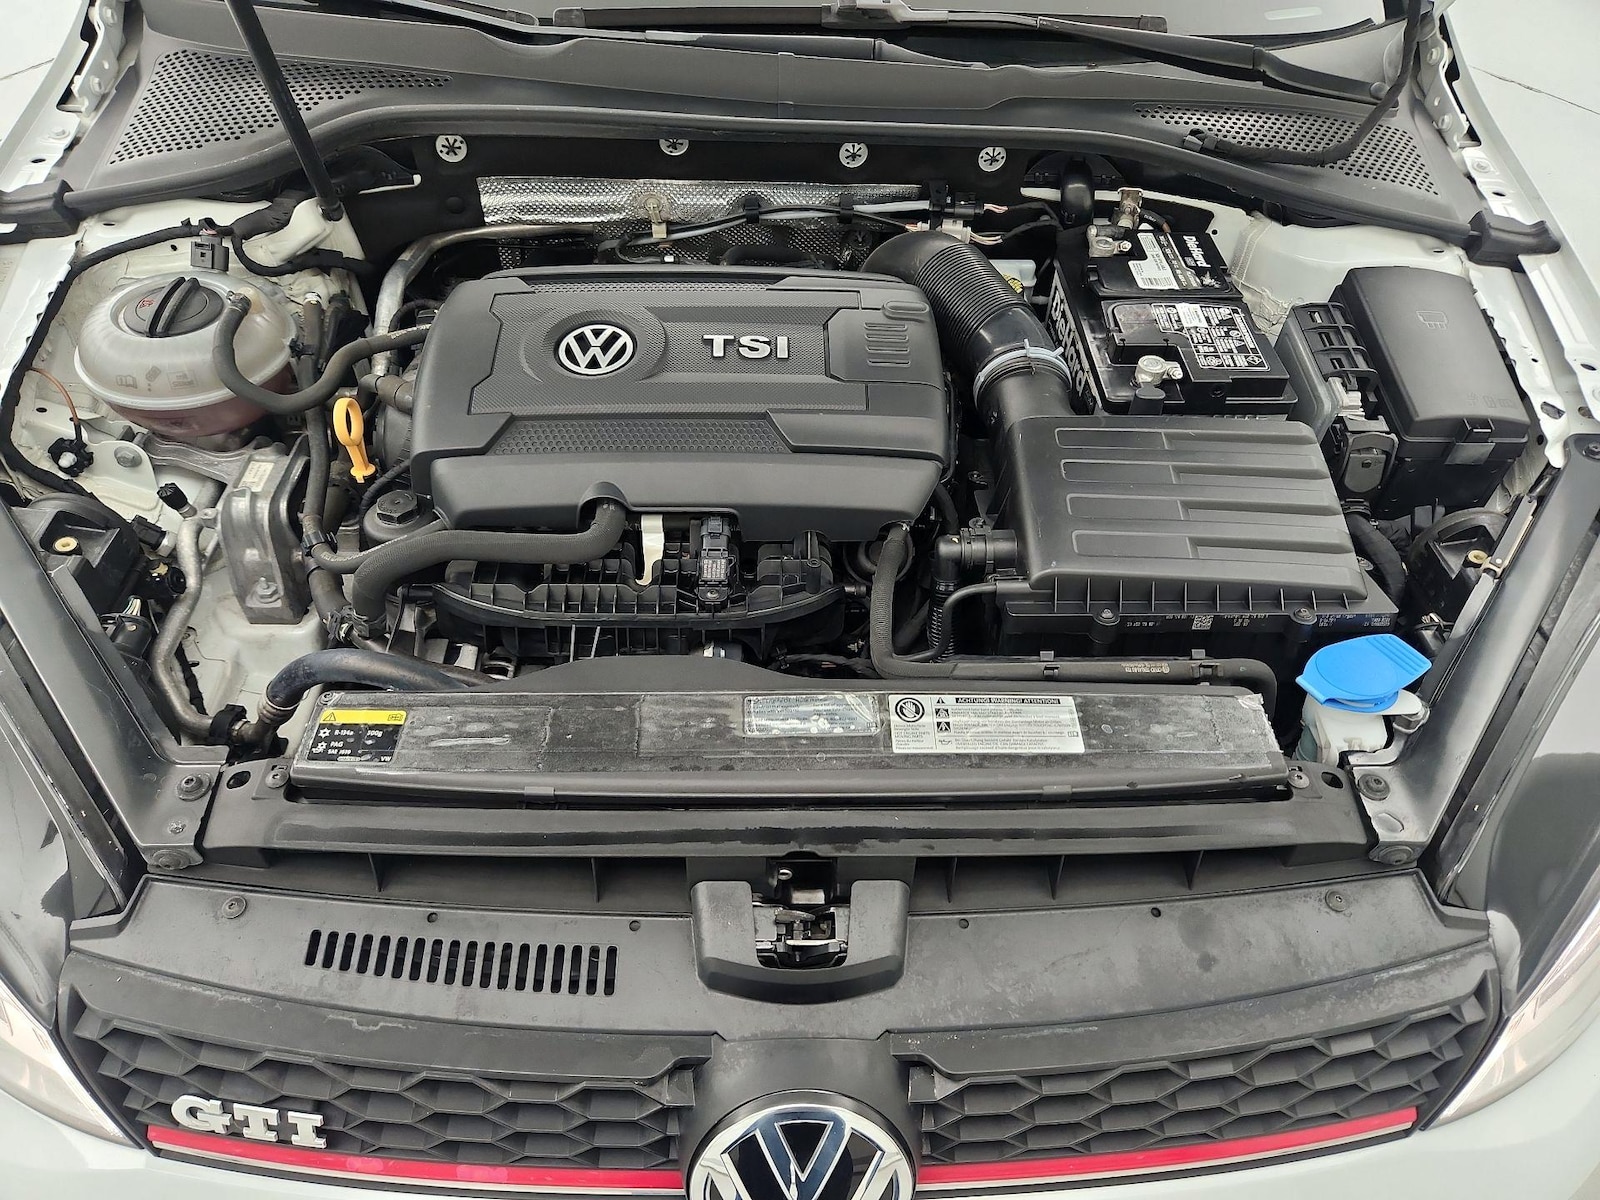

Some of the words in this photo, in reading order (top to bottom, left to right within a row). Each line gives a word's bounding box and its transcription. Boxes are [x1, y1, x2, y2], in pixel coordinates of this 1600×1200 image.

[1183, 235, 1211, 267] DieHard
[702, 334, 790, 360] TSI
[171, 1094, 327, 1149] GTI
